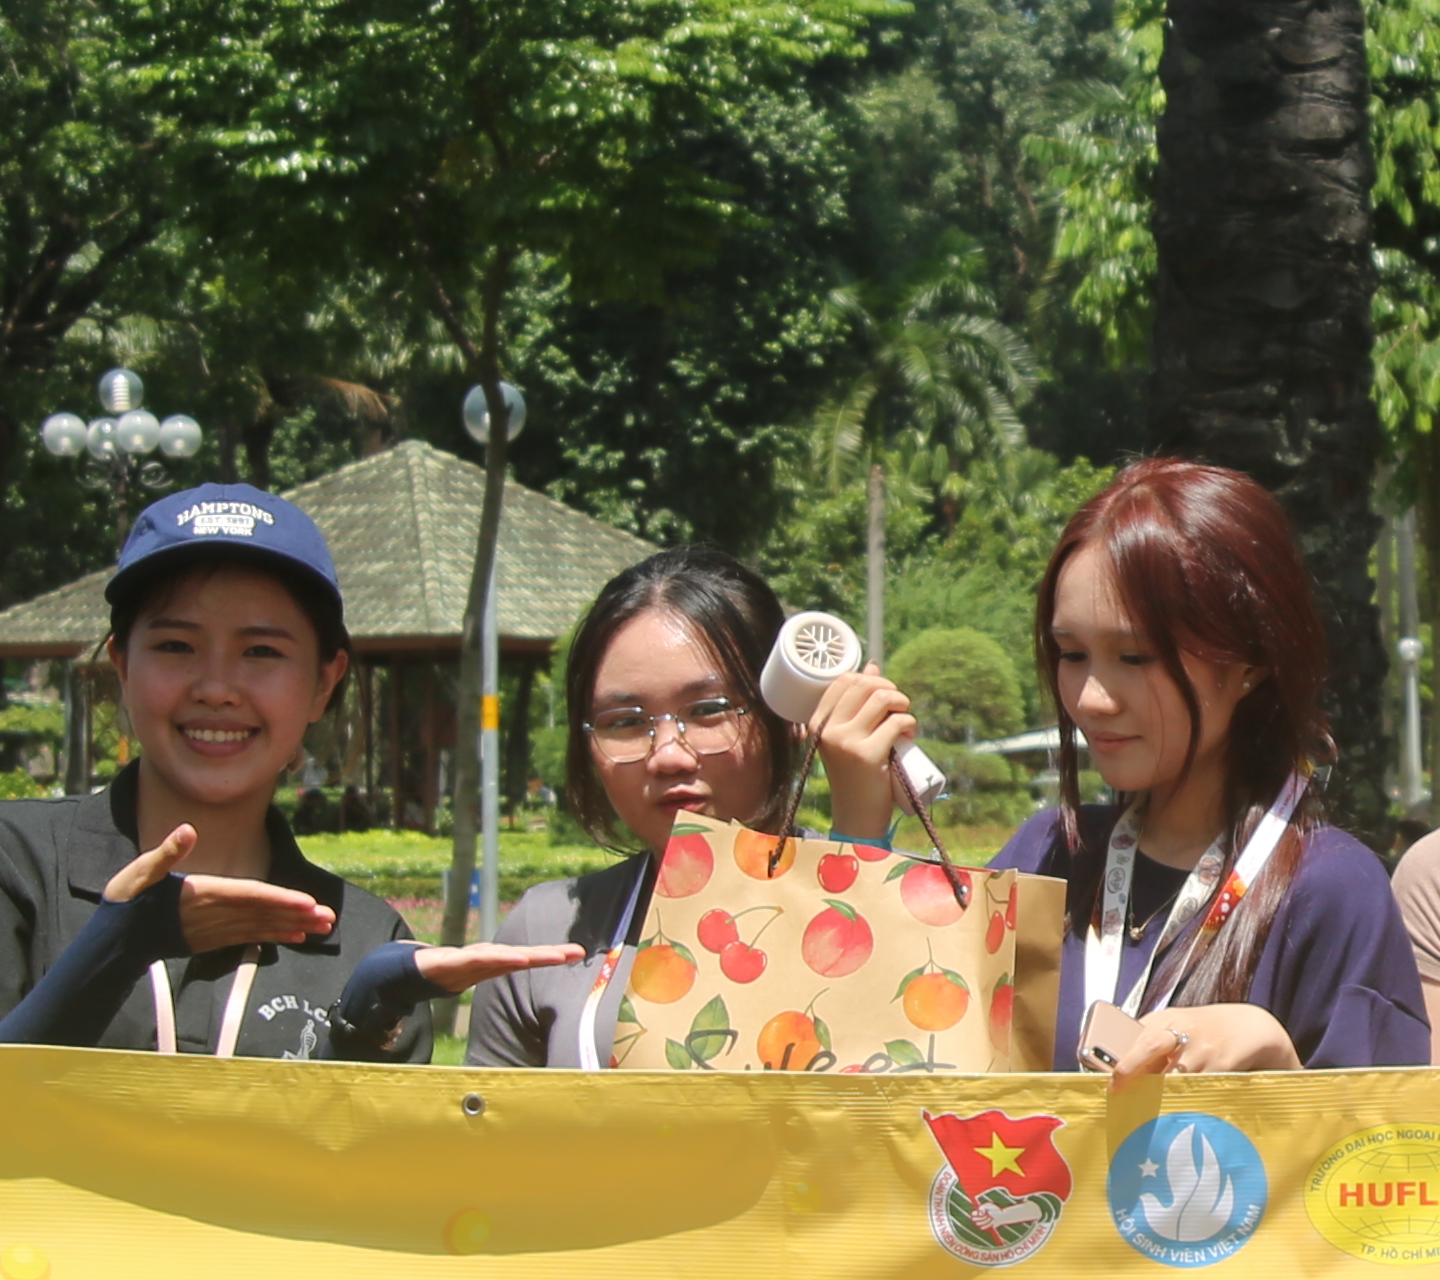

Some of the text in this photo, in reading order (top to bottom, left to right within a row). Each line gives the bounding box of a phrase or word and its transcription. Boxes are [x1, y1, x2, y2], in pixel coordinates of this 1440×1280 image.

[177, 501, 275, 526] HAMPTONS
[193, 525, 253, 536] NEW YORK
[257, 994, 332, 1028] BCH LC
[1366, 1130, 1394, 1145] HỌC
[1132, 1232, 1167, 1259] SINH
[1170, 1247, 1207, 1263] VIÊN
[1207, 1233, 1241, 1259] VIỆT
[1237, 1203, 1262, 1237] NAM
